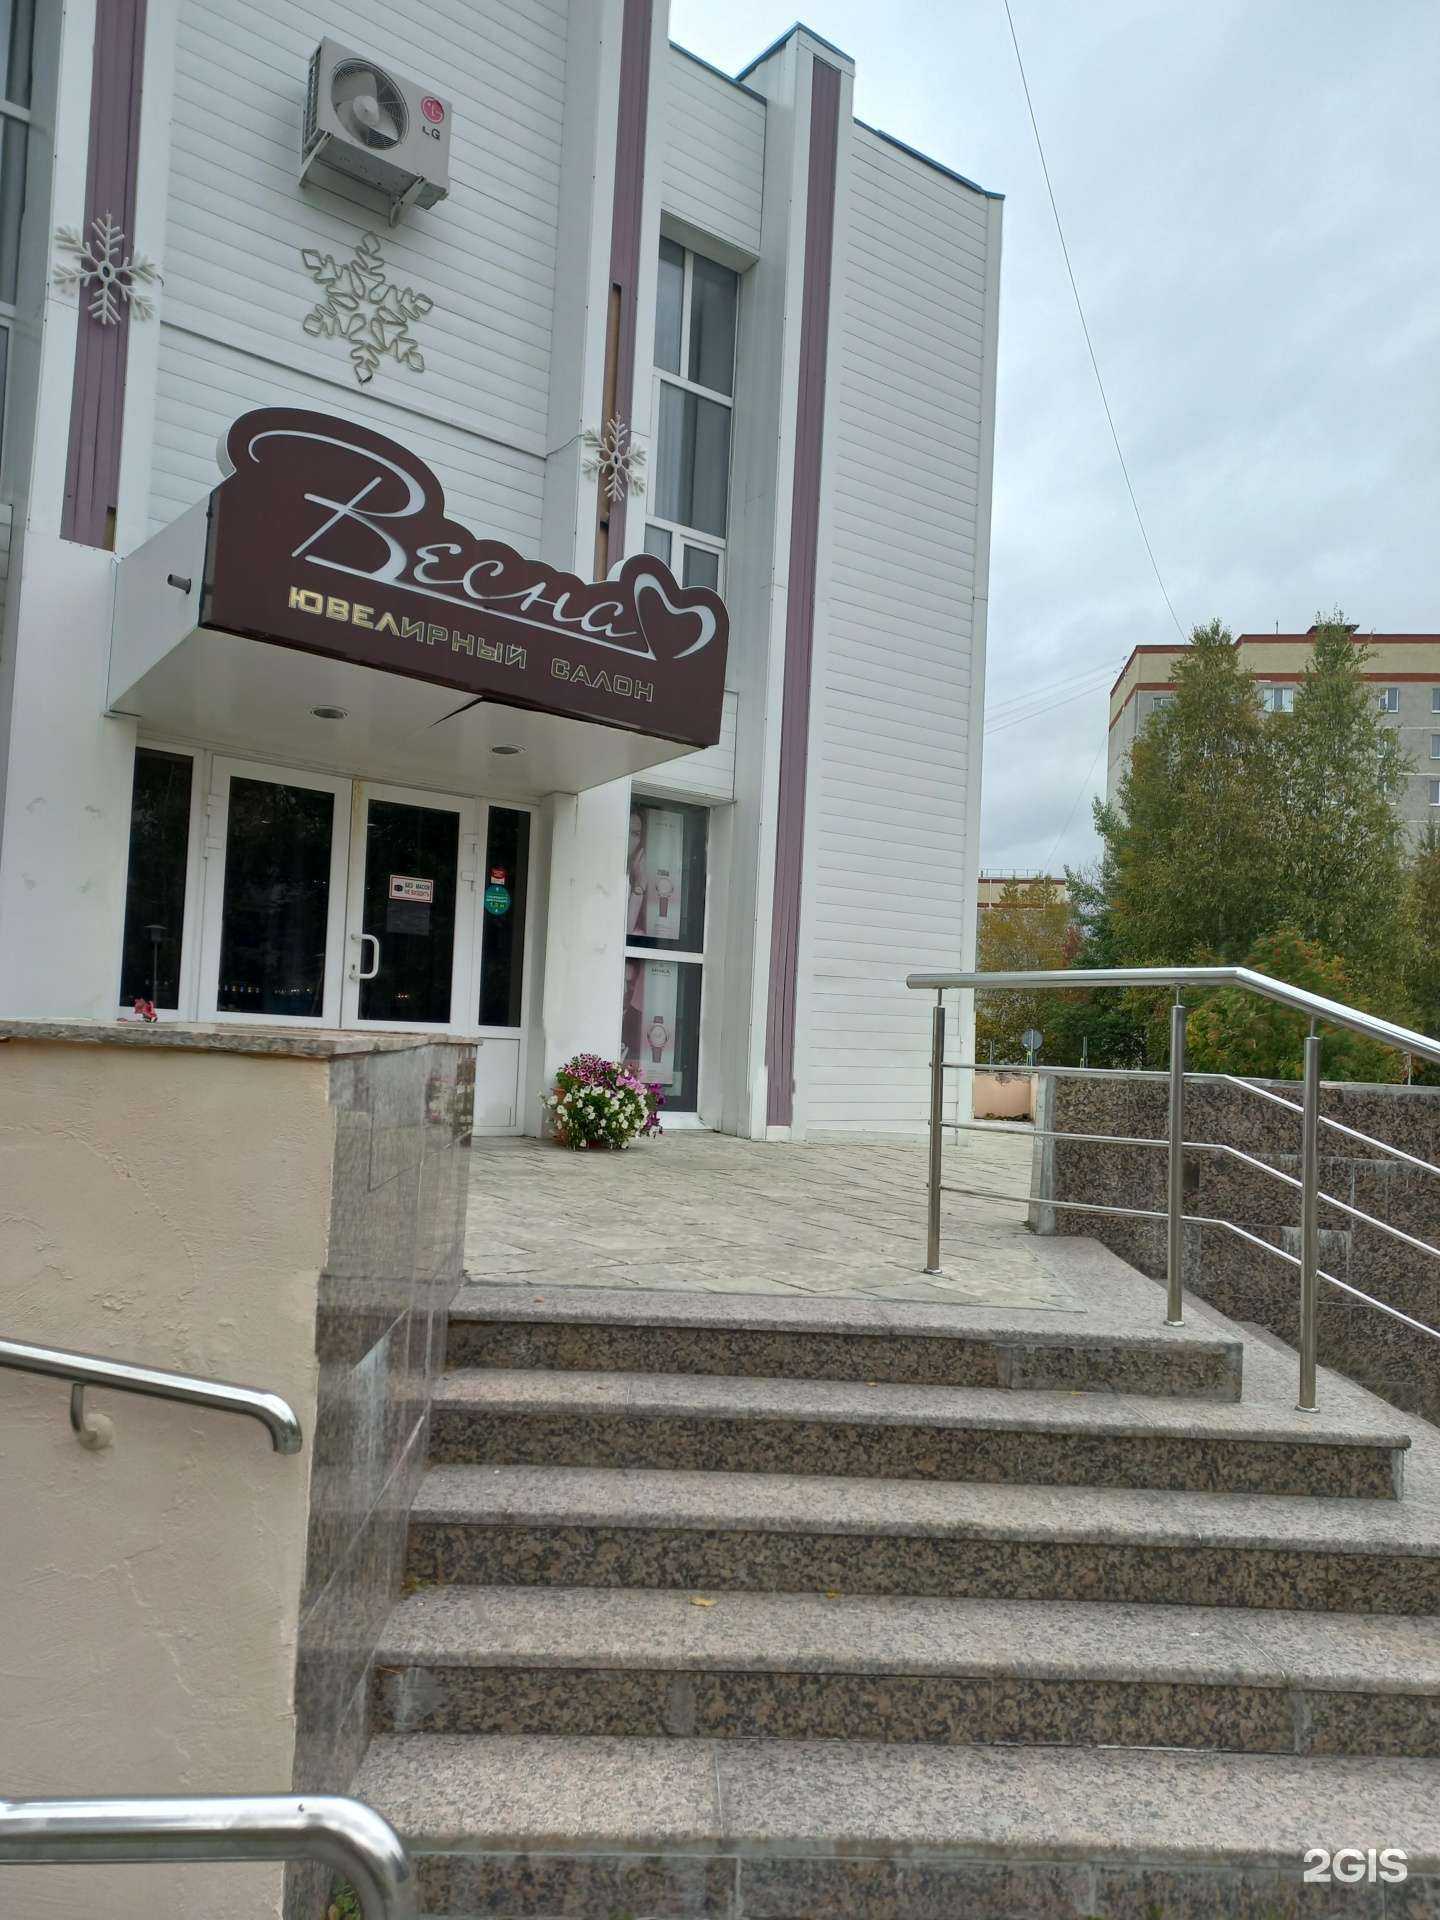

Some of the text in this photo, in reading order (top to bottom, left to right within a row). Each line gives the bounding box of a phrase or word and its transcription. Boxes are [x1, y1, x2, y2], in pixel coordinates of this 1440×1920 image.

[422, 126, 440, 140] LG
[248, 430, 639, 637] Весна
[288, 585, 655, 702] ЮВЕЛИРНЫЙ САЛОН
